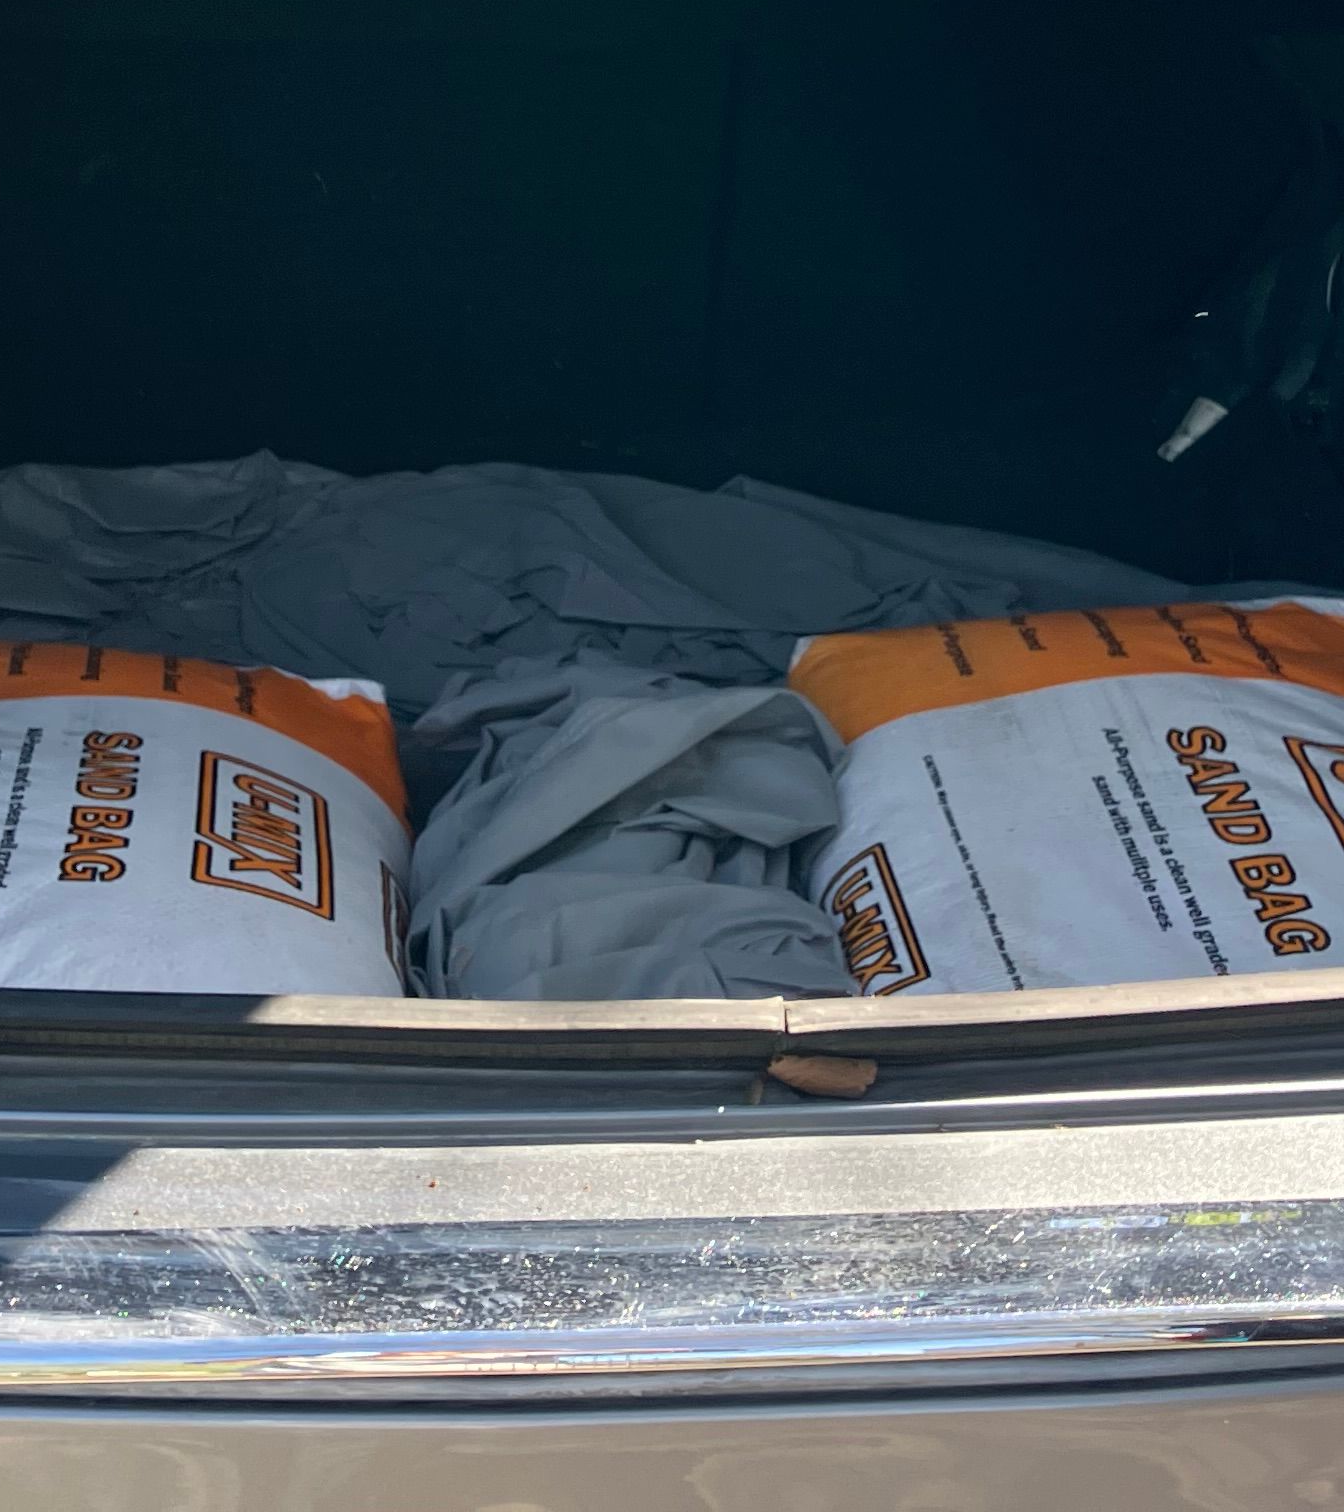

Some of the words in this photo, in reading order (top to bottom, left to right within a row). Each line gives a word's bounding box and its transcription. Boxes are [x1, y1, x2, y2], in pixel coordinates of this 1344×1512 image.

[75, 730, 143, 800] SAND
[1102, 728, 1146, 799] All-Purpose
[229, 773, 303, 890] U-MIX
[1092, 775, 1120, 806] sand
[1108, 807, 1132, 836] with
[1137, 800, 1166, 832] sand
[0, 829, 19, 850] well
[58, 804, 133, 881] BAG
[1153, 833, 1169, 845] is
[1159, 847, 1173, 856] a
[1166, 726, 1272, 845] SAND
[1228, 854, 1332, 956] BAG
[1165, 858, 1192, 895] clean
[831, 867, 902, 996] U-MIX
[1184, 896, 1212, 928] well
[1192, 929, 1231, 976] grade
